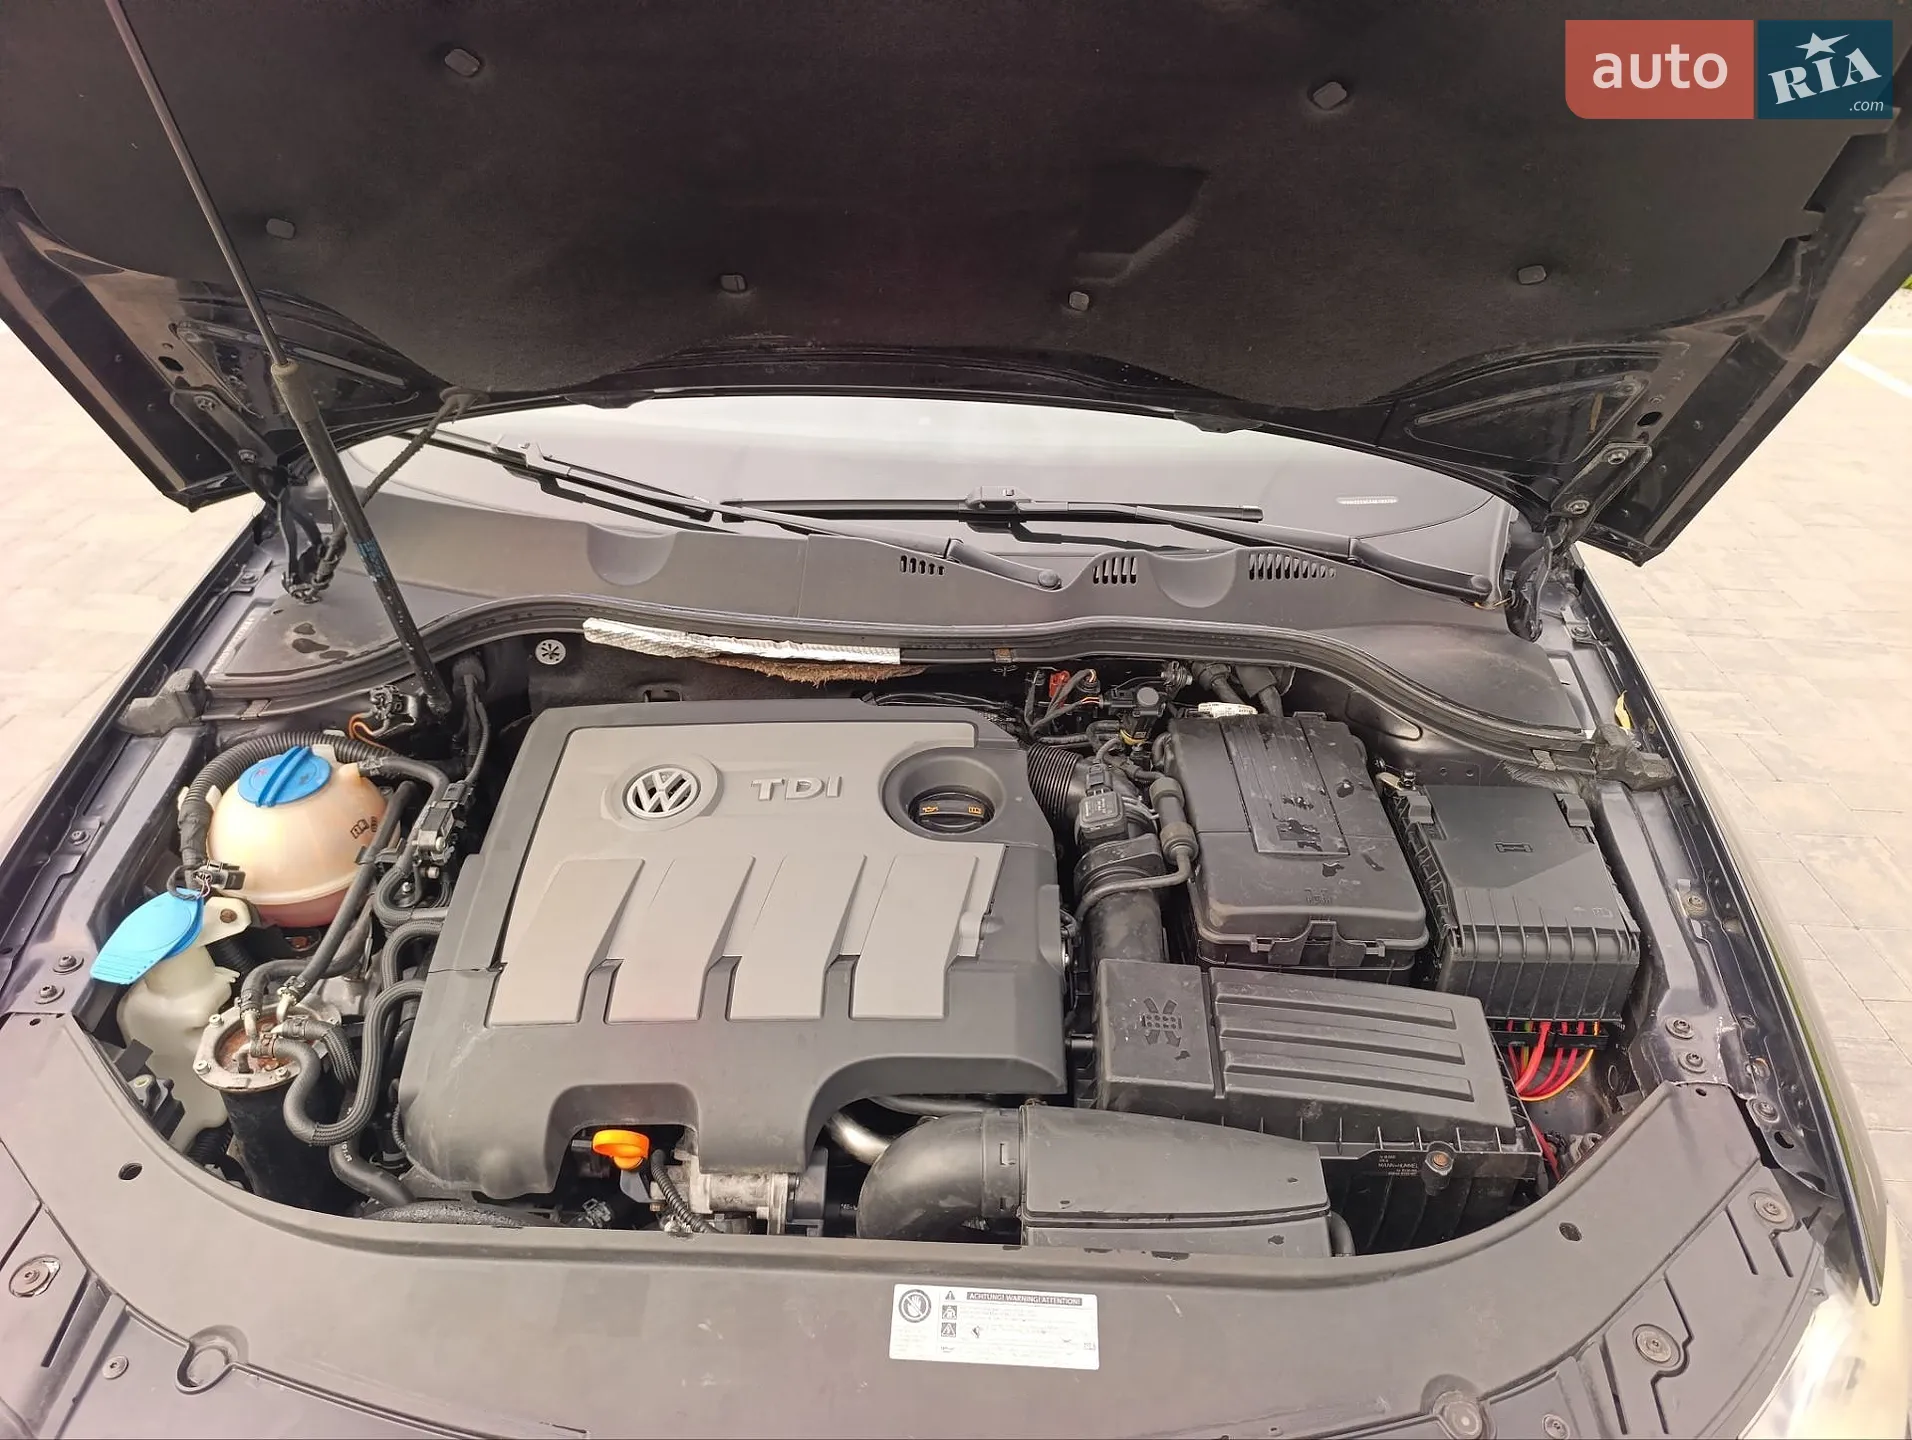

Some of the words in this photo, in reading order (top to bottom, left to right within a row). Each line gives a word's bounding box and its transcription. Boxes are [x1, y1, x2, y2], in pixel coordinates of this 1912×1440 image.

[751, 776, 843, 802] TDI
[968, 1292, 1005, 1301] ACHTUNG!
[1006, 1294, 1040, 1304] WARNING!
[1041, 1296, 1081, 1306] ATTENTION!
